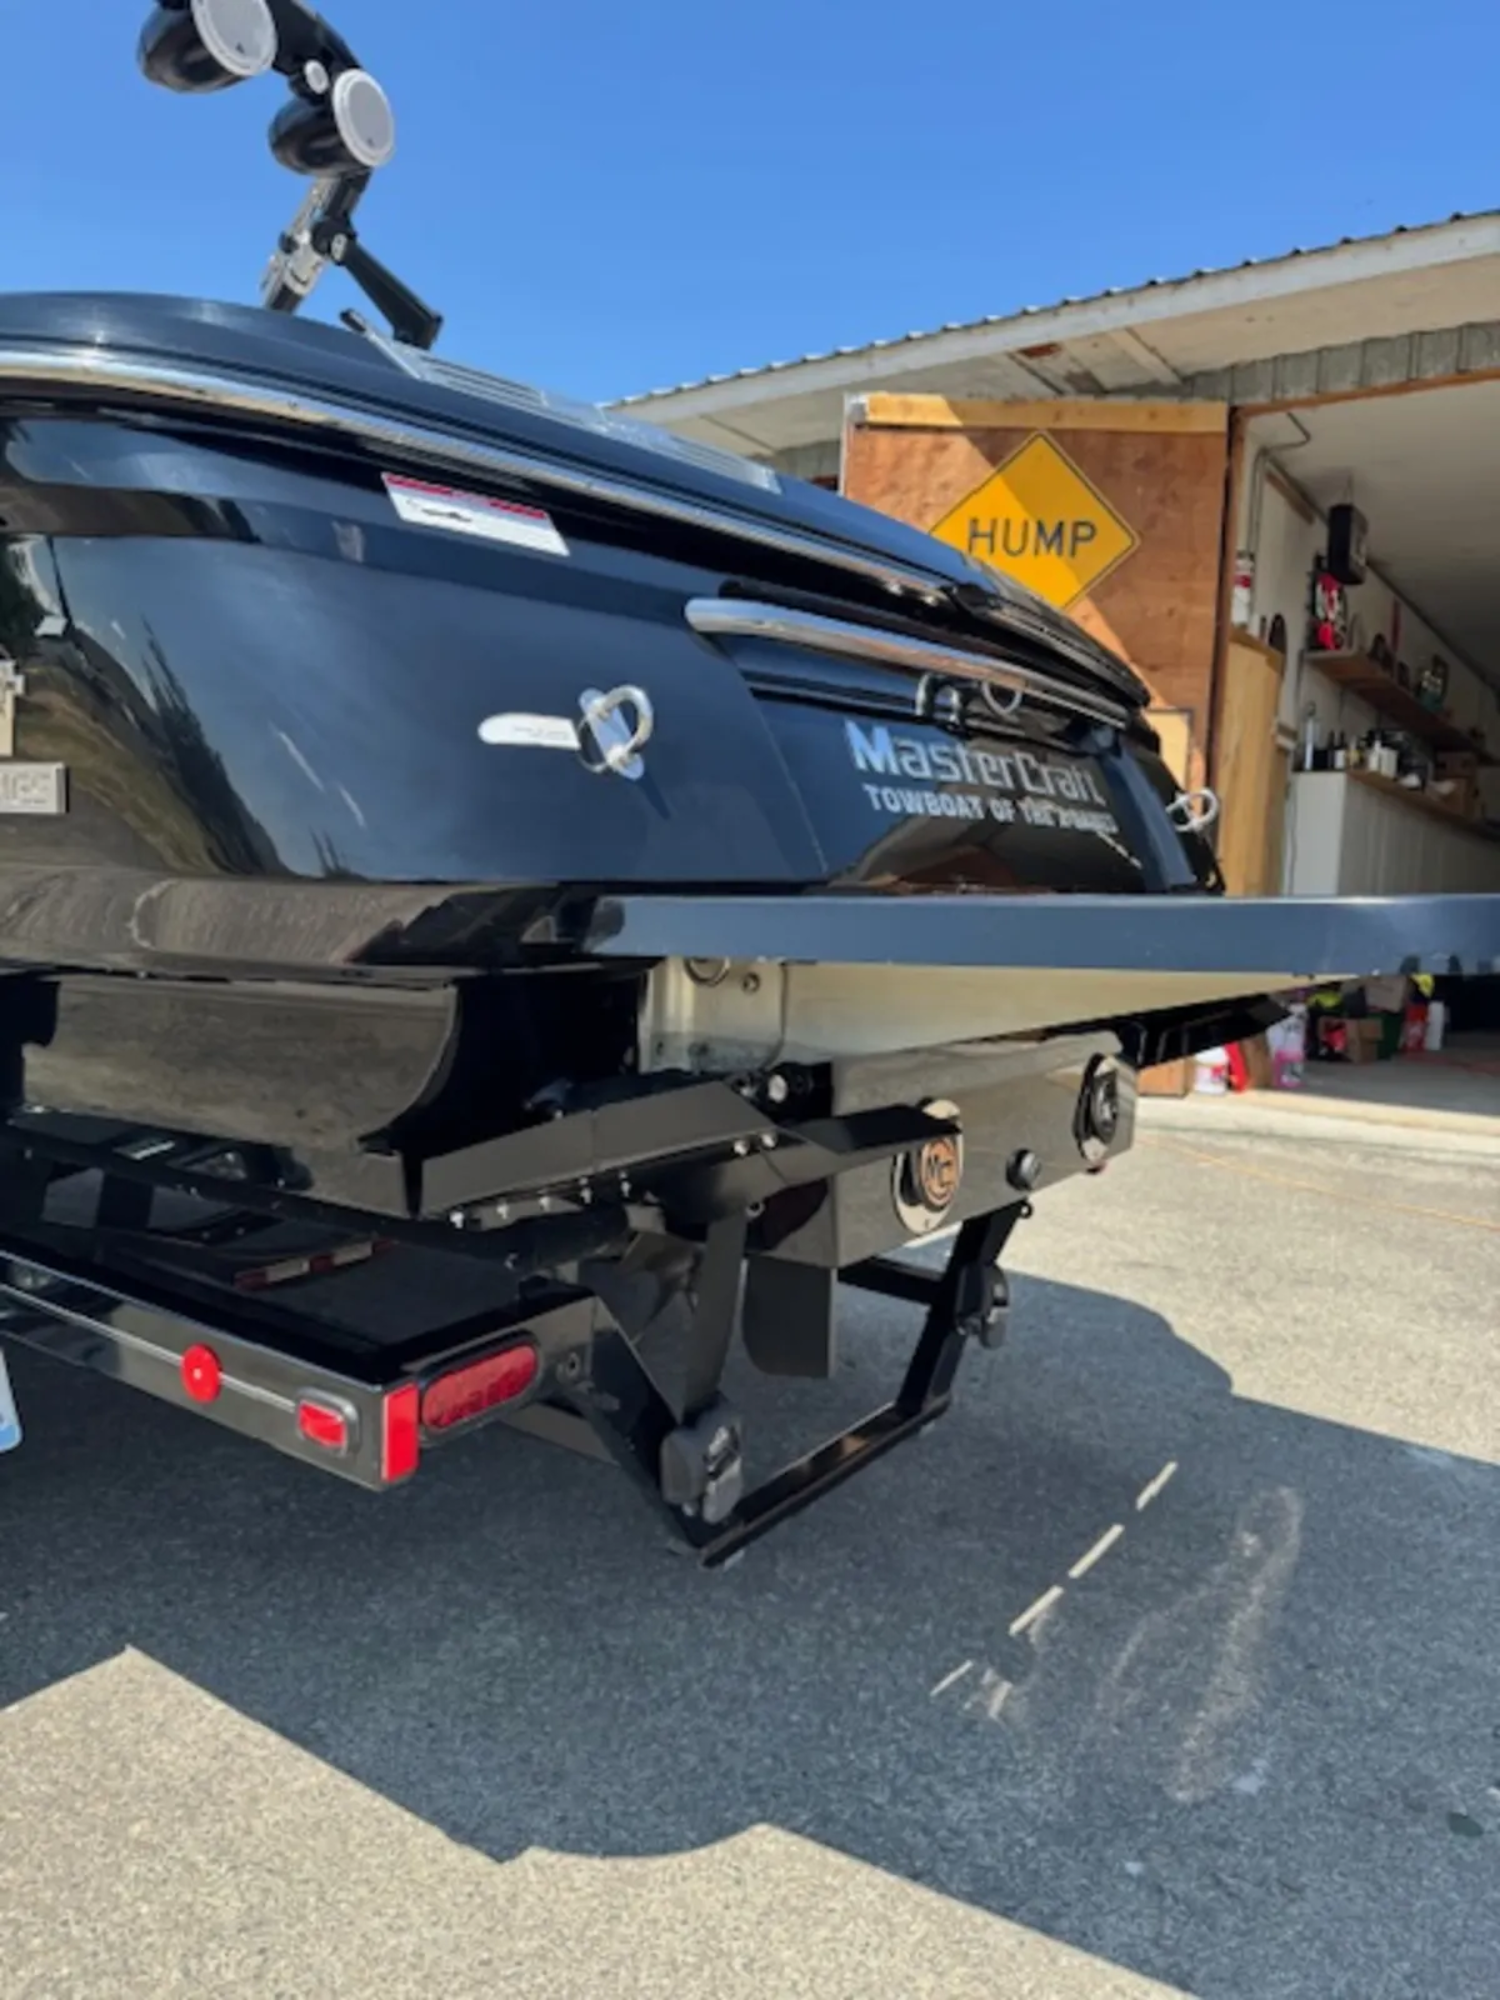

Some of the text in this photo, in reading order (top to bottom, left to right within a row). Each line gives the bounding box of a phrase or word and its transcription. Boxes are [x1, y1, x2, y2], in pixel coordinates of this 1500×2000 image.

[968, 517, 1098, 559] HUMP
[845, 718, 1105, 806] MasterCraft
[862, 782, 985, 820] TOWBOAT
[989, 797, 1016, 823] OF
